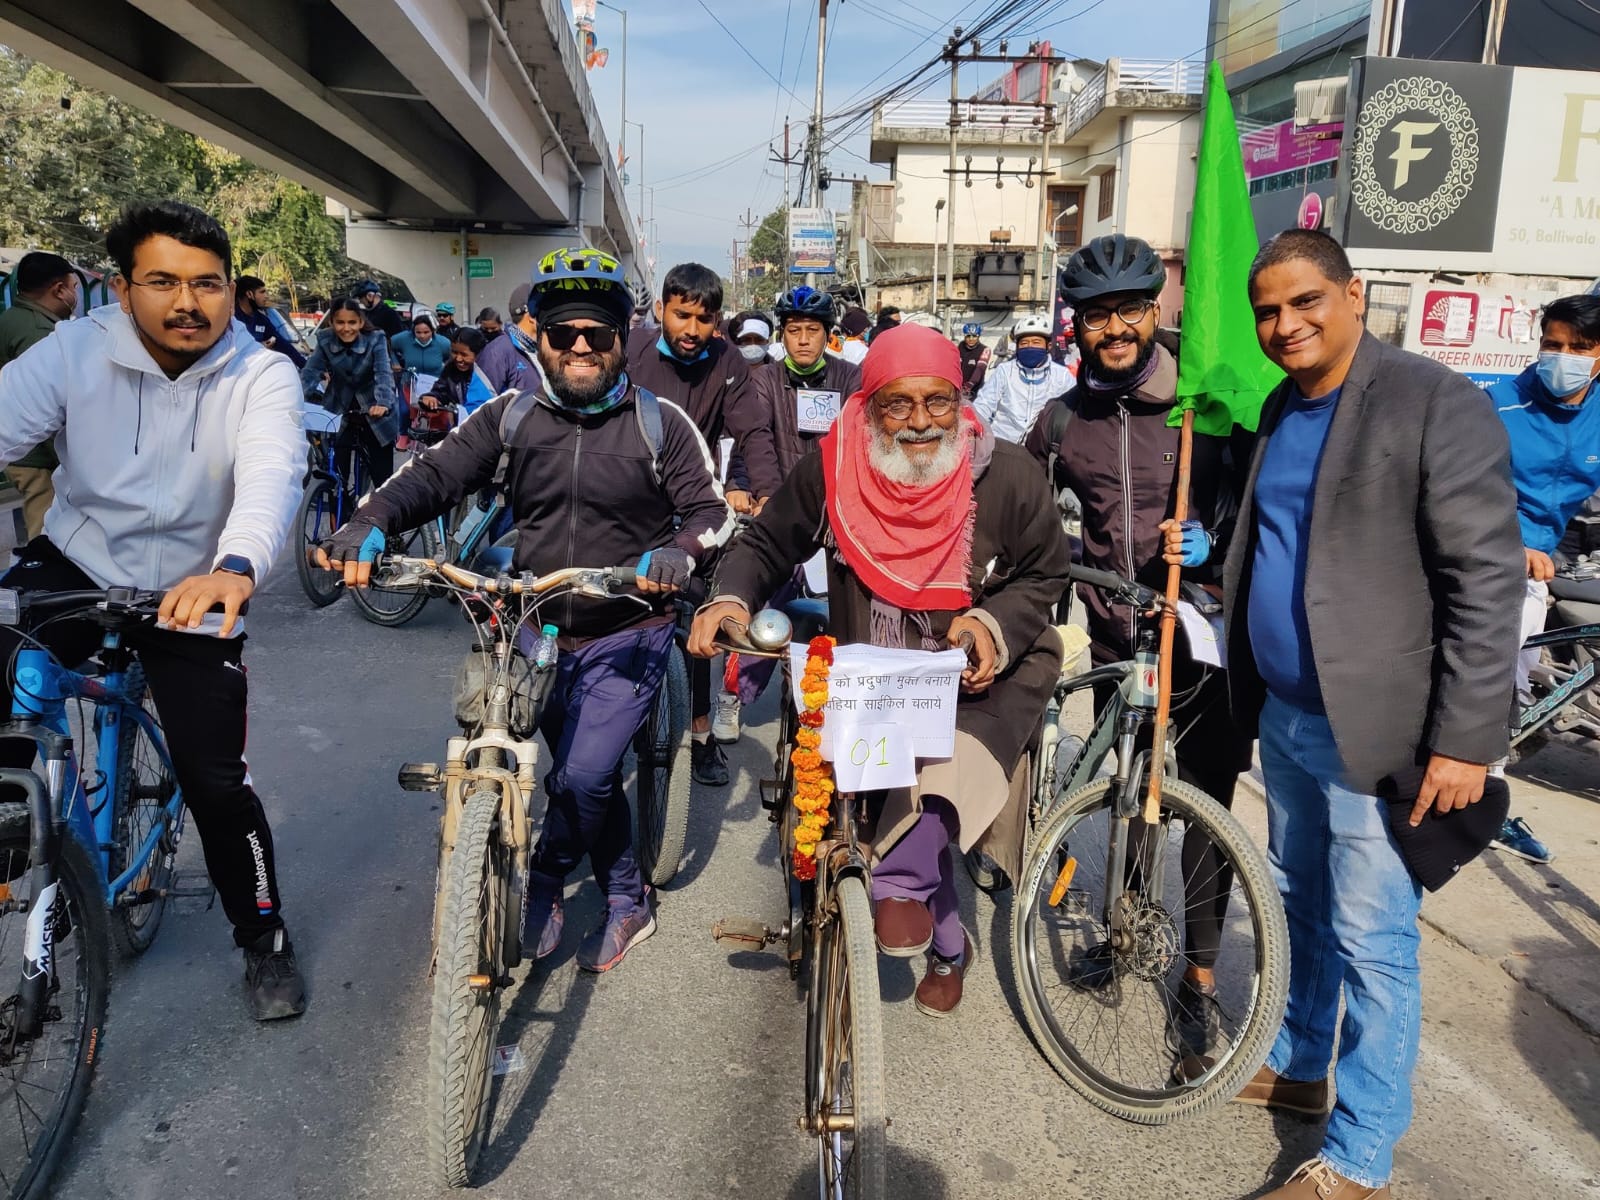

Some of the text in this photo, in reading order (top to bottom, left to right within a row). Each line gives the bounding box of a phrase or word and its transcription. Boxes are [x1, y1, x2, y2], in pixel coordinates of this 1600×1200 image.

[1389, 120, 1441, 190] F
[1472, 352, 1534, 368] INSTITUTE
[835, 674, 851, 688] को
[822, 695, 857, 711] पहिया
[850, 736, 889, 767] 01
[245, 829, 269, 891] Motorsport
